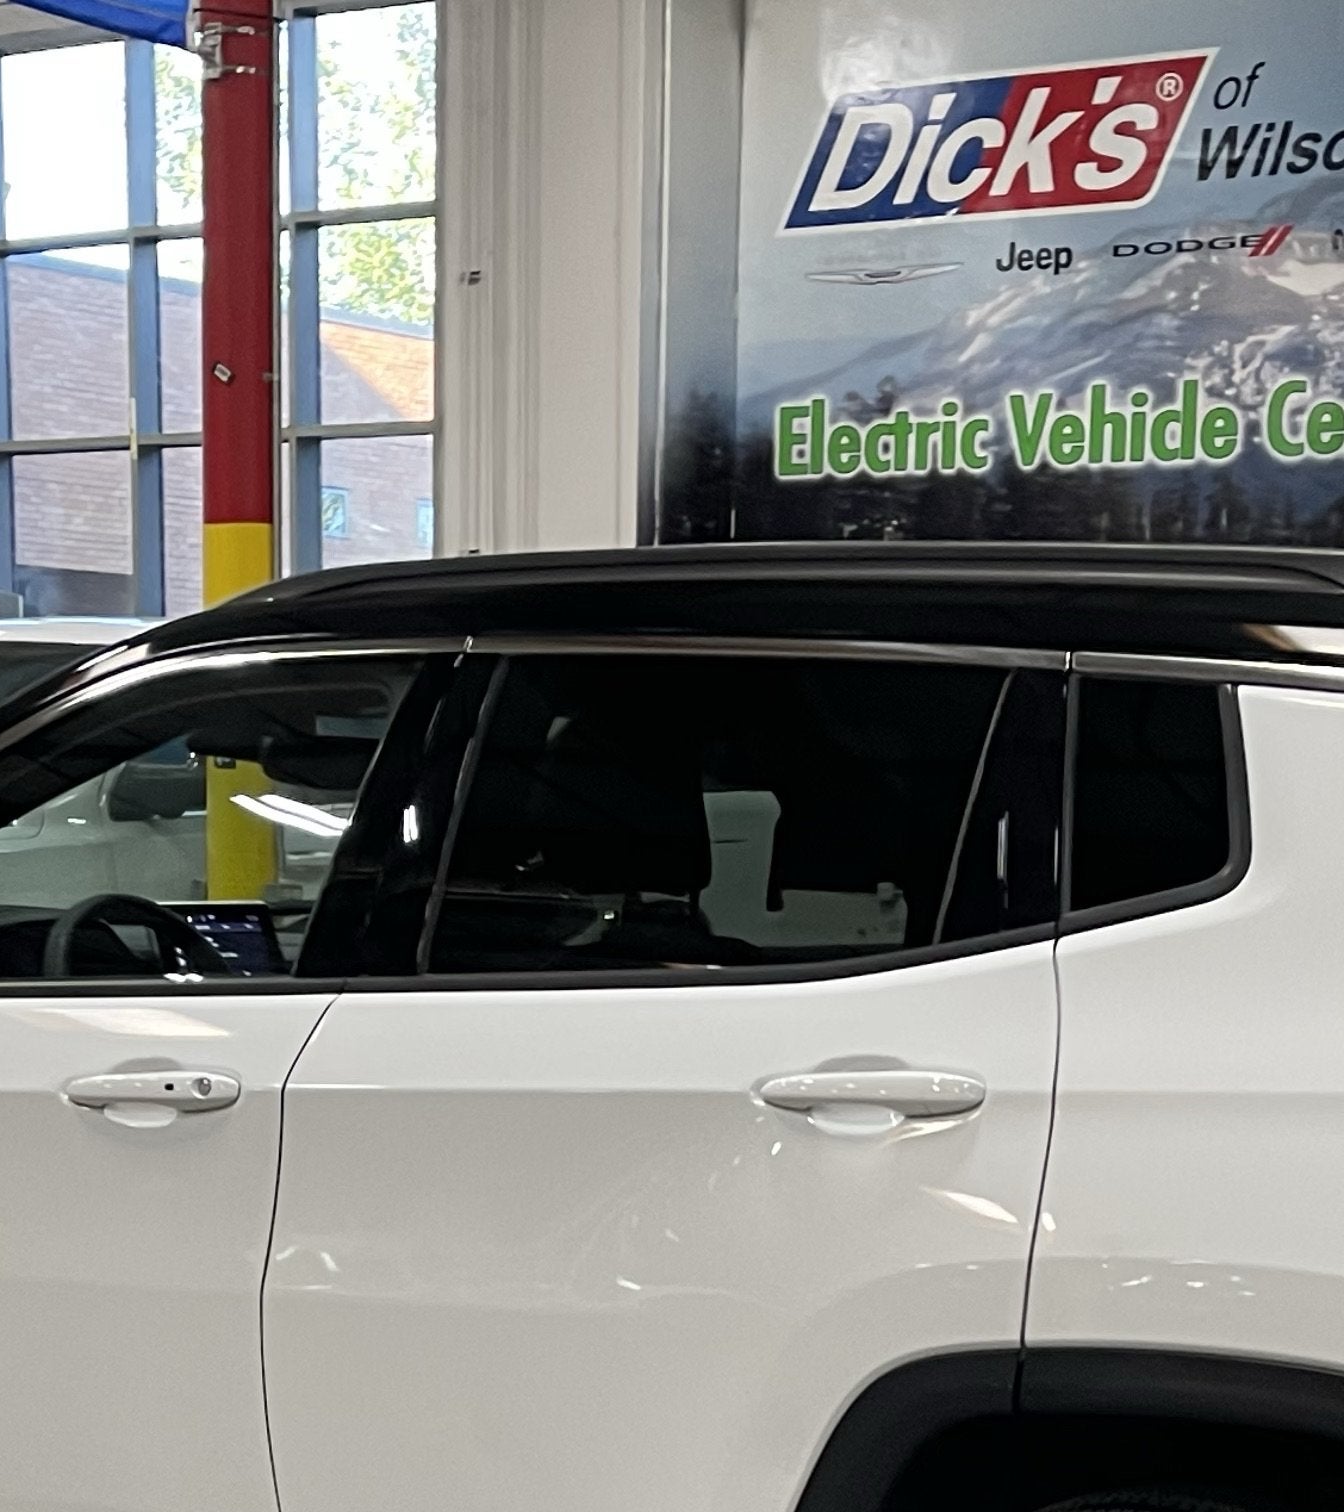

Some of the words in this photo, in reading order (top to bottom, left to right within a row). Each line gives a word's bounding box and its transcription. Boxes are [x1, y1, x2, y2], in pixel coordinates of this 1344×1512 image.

[1213, 61, 1265, 110] of
[996, 241, 1072, 275] Jeep
[1112, 233, 1264, 257] DODGE
[776, 397, 991, 477] Electric
[1009, 379, 1240, 468] Vehicle
